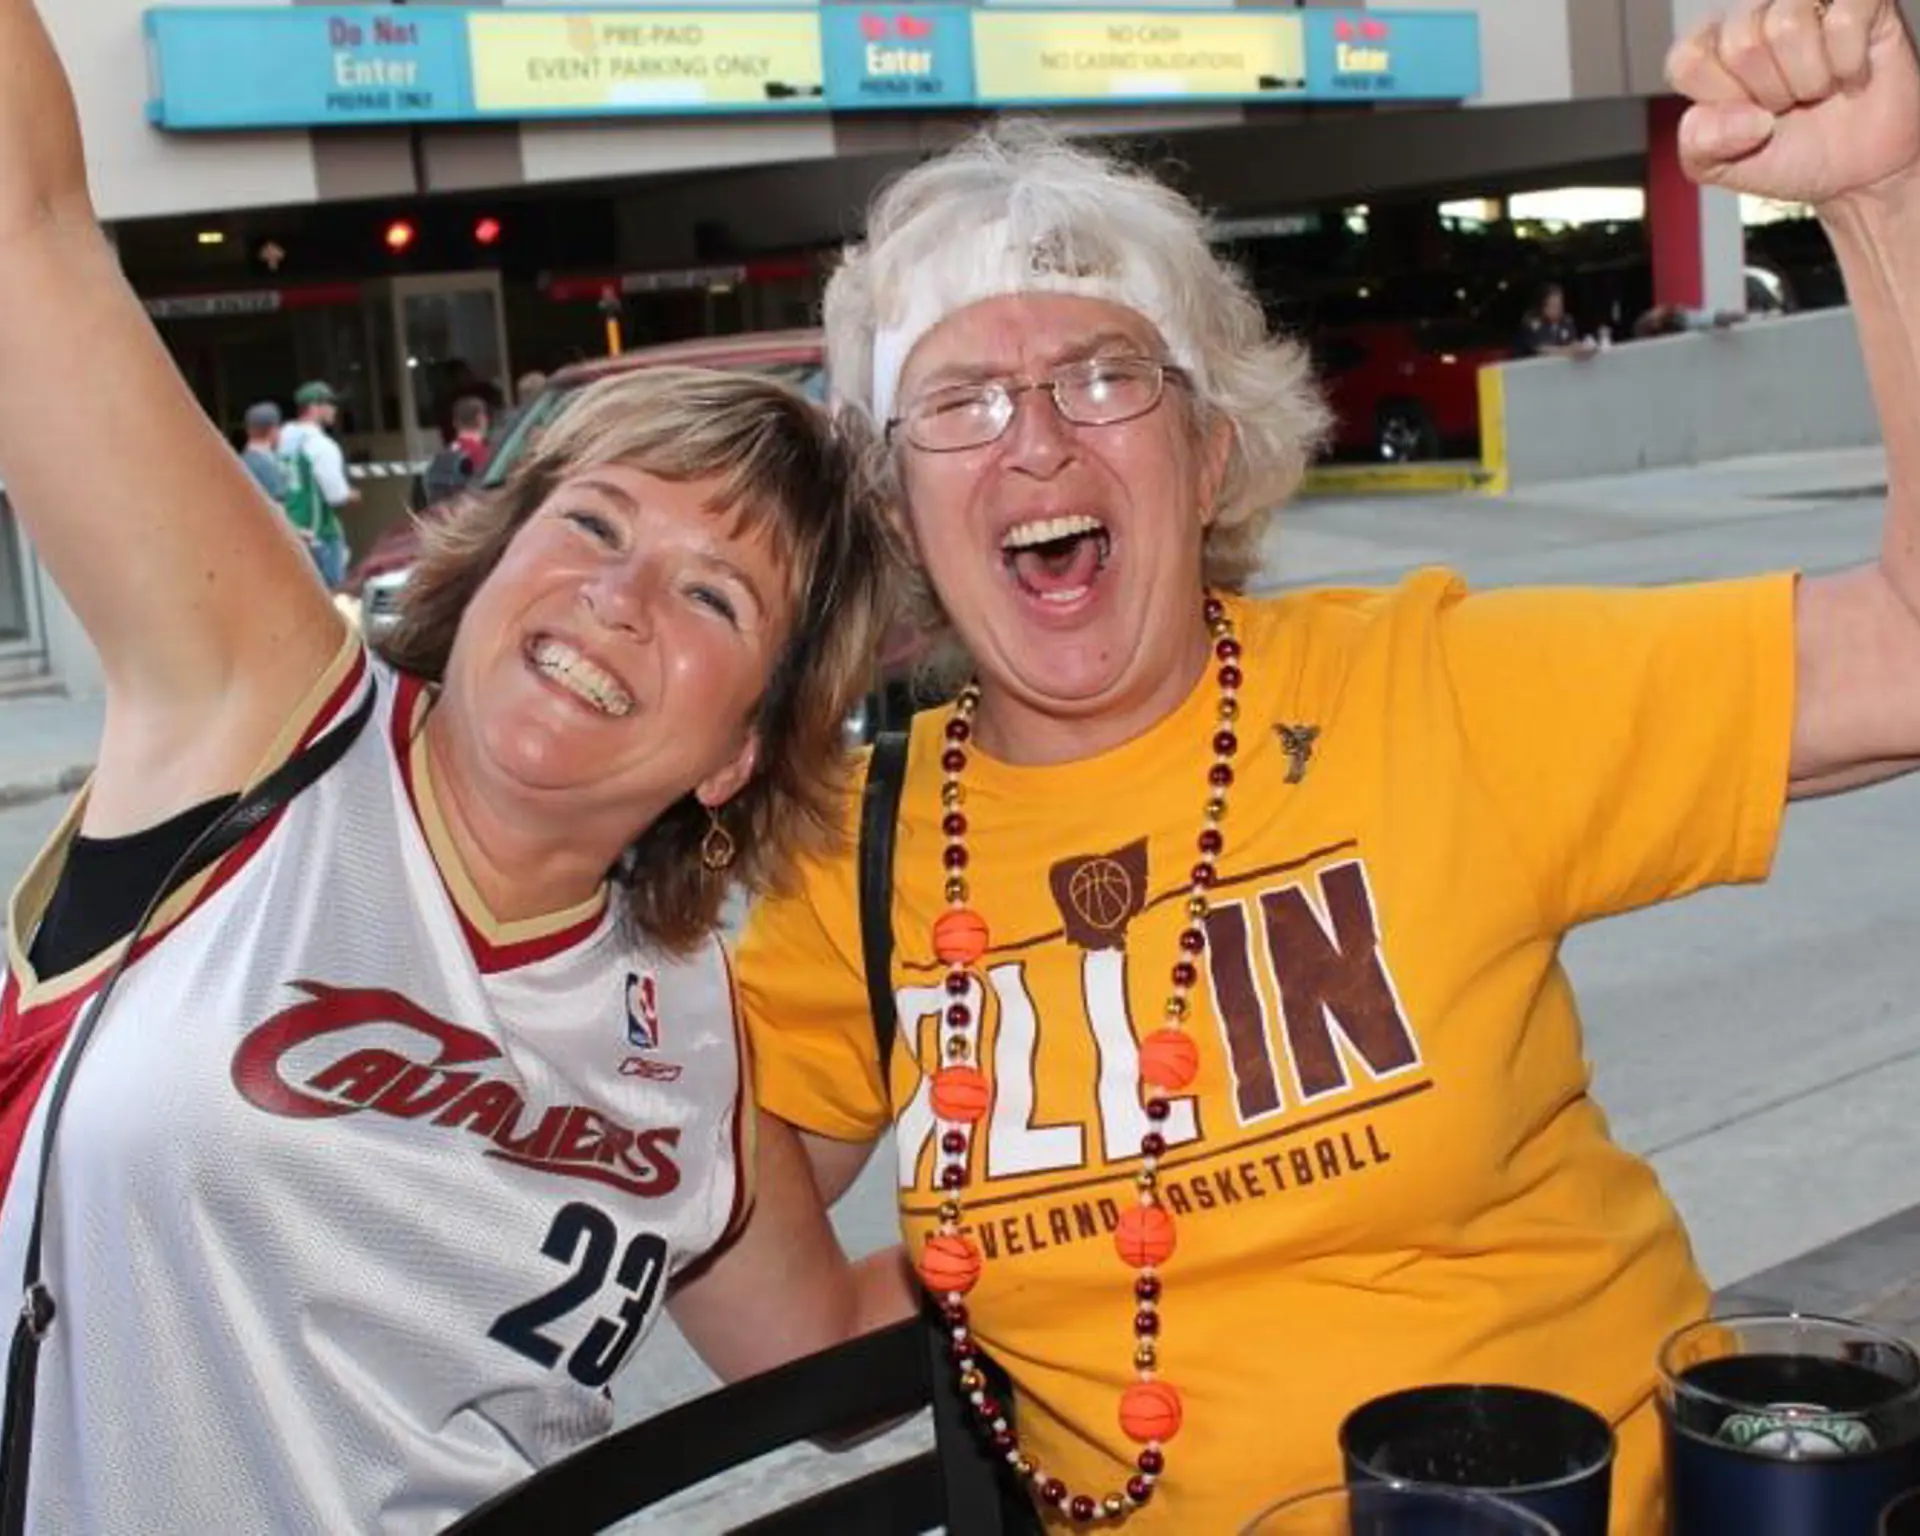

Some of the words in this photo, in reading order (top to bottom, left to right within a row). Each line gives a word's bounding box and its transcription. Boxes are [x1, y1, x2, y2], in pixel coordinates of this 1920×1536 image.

[329, 16, 362, 47] Do
[372, 16, 418, 46] Not
[602, 24, 704, 47] PRE-PAID
[333, 52, 418, 87] Enter
[526, 56, 600, 82] EVENT
[609, 55, 708, 78] PARKING
[713, 54, 771, 78] ONLY
[866, 43, 932, 76] Enter
[1336, 43, 1388, 74] Enter
[1202, 857, 1423, 1128] IN
[230, 979, 682, 1198] CAVALIERS
[925, 1196, 1121, 1260] VELAND
[487, 1201, 668, 1388] 23
